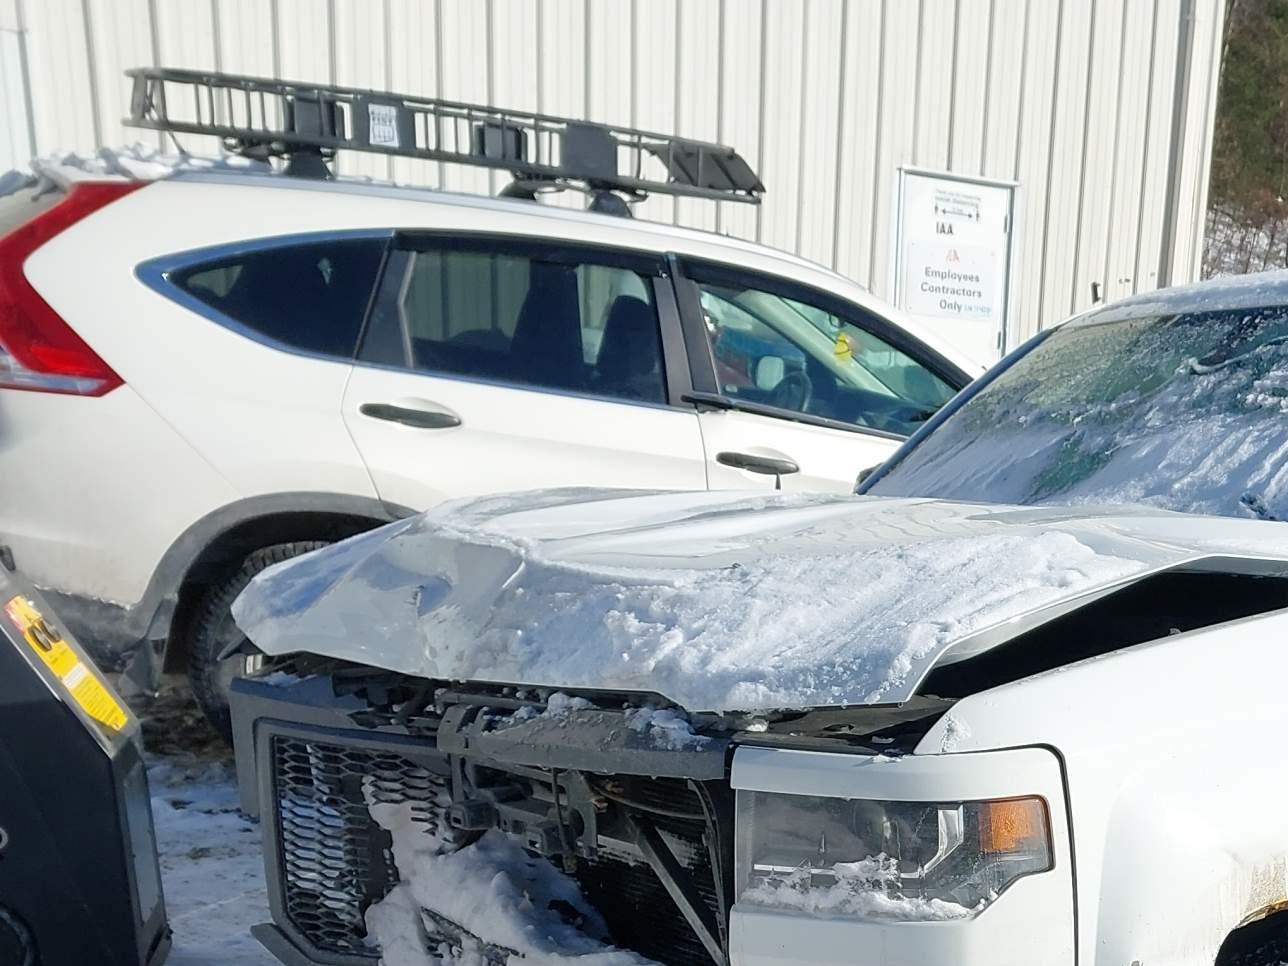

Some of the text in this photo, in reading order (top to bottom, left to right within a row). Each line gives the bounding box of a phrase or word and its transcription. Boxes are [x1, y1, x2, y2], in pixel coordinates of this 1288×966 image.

[935, 221, 954, 235] IAA
[925, 266, 980, 283] Employees
[920, 281, 982, 298] Contractors
[939, 299, 962, 313] Only
